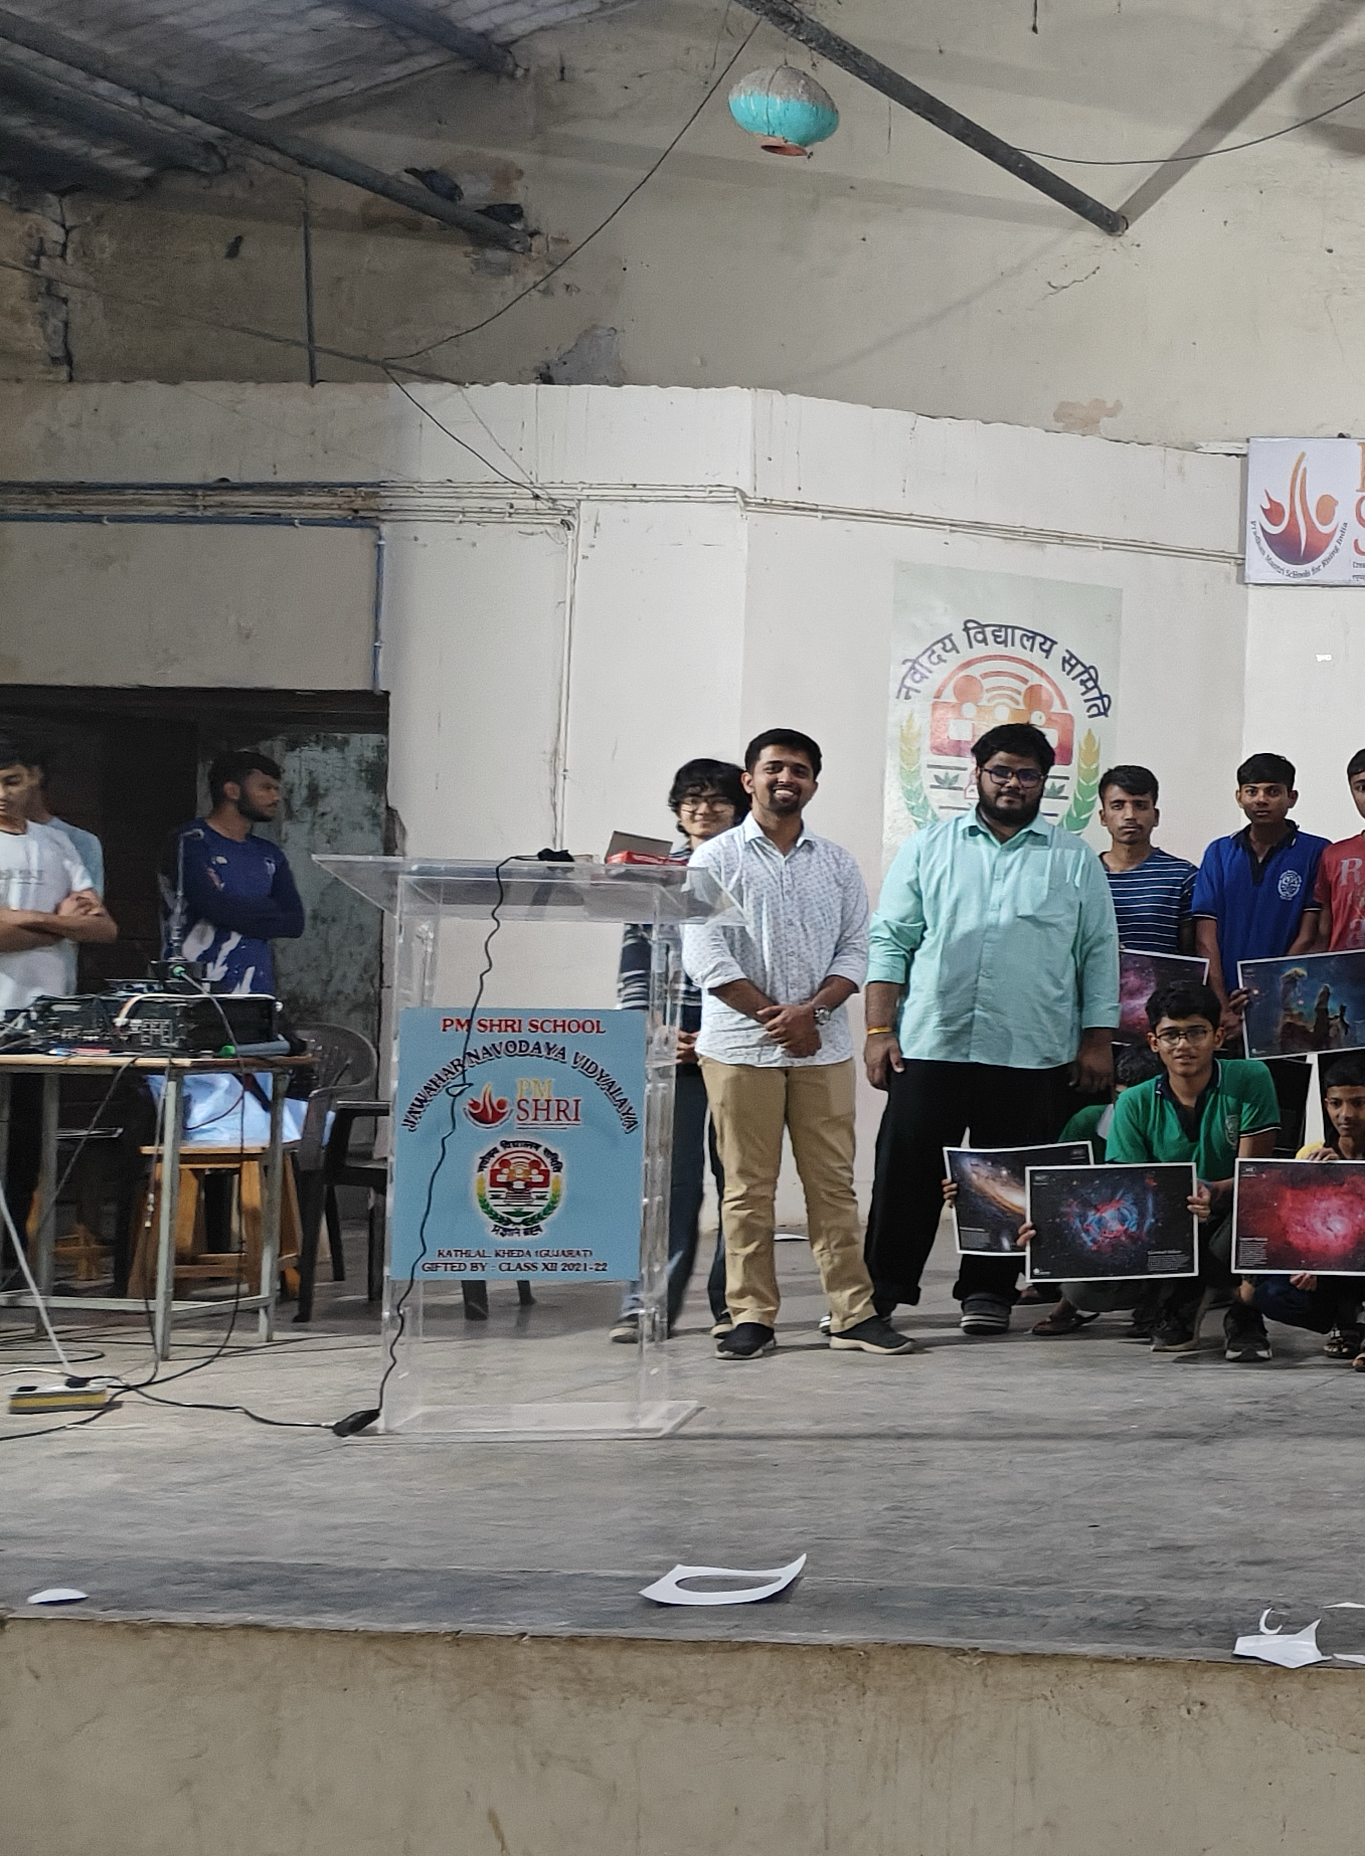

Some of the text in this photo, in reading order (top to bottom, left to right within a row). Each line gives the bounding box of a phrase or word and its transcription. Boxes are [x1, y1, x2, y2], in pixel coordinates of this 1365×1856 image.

[896, 619, 1112, 719] नवोदय विद्यालय समिति
[442, 1018, 606, 1034] PM SHRI SCHOOL
[401, 1040, 639, 1134] JAWAHAR NAVODAYA VIDYALAYA
[516, 1078, 552, 1099] PM
[516, 1098, 582, 1122] SHRI
[422, 1262, 467, 1272] GIFTED
[469, 1262, 487, 1272] BY
[498, 1262, 538, 1272] CLASS
[541, 1262, 558, 1272] XII
[561, 1262, 608, 1272] 2021-22
